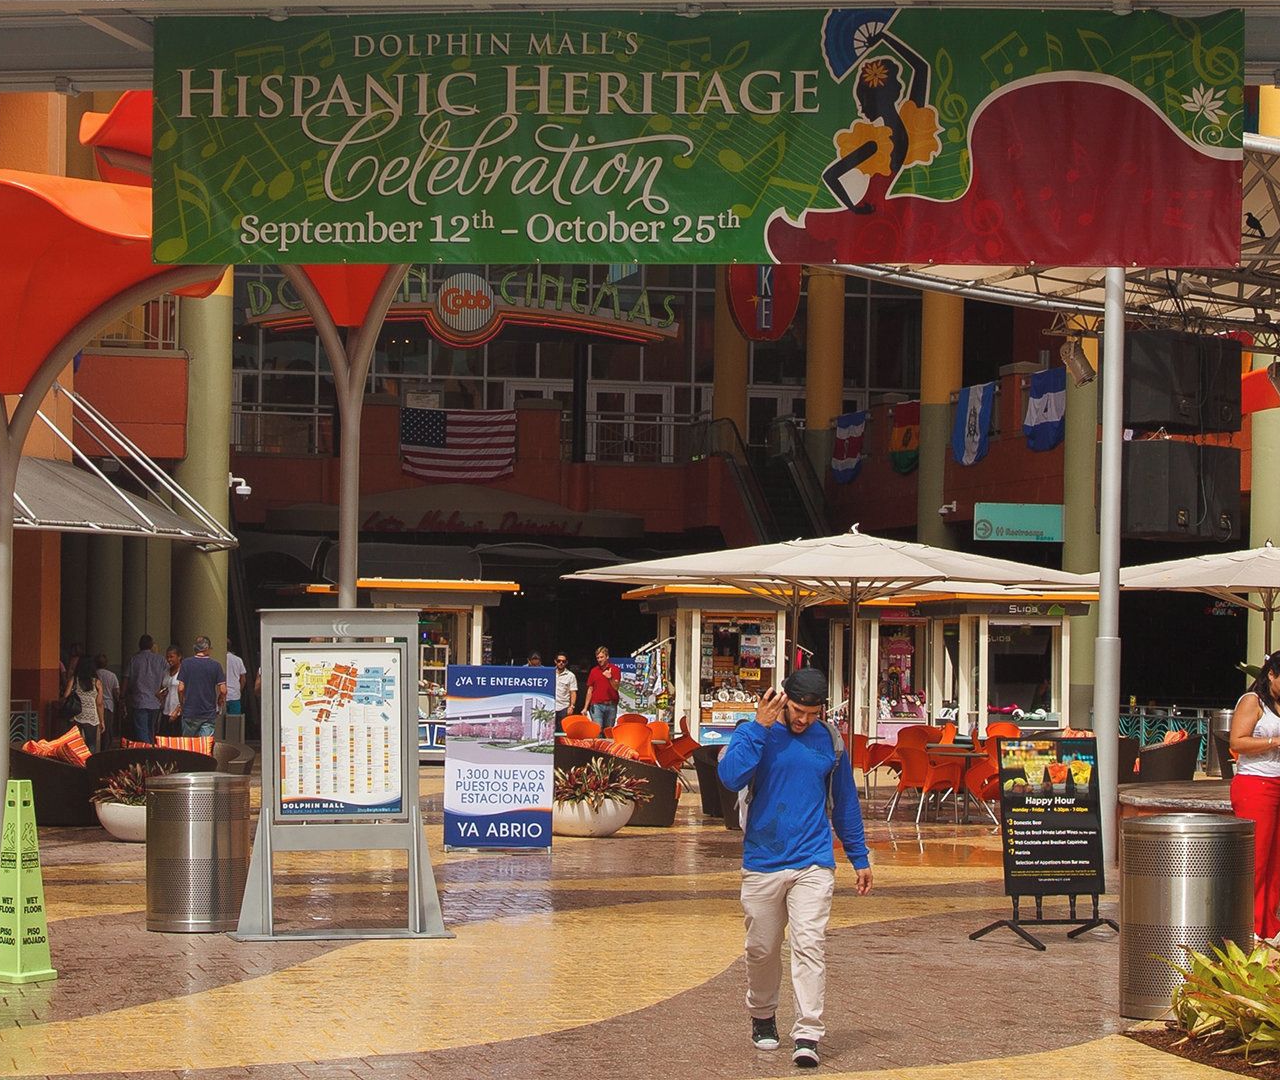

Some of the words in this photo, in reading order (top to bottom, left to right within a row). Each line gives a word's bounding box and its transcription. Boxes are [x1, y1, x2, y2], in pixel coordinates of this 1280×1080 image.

[353, 32, 510, 57] DOLPHIN
[528, 31, 639, 55] MALL'S
[176, 67, 478, 118] HISPANIC
[501, 64, 821, 115] HERITAGE
[302, 102, 696, 216] Celebration
[240, 211, 422, 253] September
[429, 209, 496, 244] 12th
[526, 210, 667, 245] October
[673, 208, 741, 244] 25th
[440, 287, 491, 316] Cobb
[499, 271, 677, 328] CINEMAS
[761, 265, 773, 329] KE
[455, 676, 473, 687] ¿YA
[476, 676, 487, 686] TE
[490, 677, 549, 687] ENTERASTE?
[457, 768, 489, 781] 1,300
[494, 769, 545, 780] NUEVOS
[455, 781, 508, 792] PUESTOS
[512, 782, 545, 792] PARA
[461, 793, 540, 804] ESTACIONAR
[1025, 796, 1053, 806] Happy
[1054, 796, 1076, 805] Hour
[457, 822, 480, 837] YA
[486, 823, 543, 838] ABRIO
[1, 896, 13, 904] WET
[26, 896, 38, 904] WET
[23, 905, 42, 914] FLOOR
[0, 927, 12, 936] PISO
[27, 927, 40, 935] PISO
[23, 936, 46, 945] MOJADO
